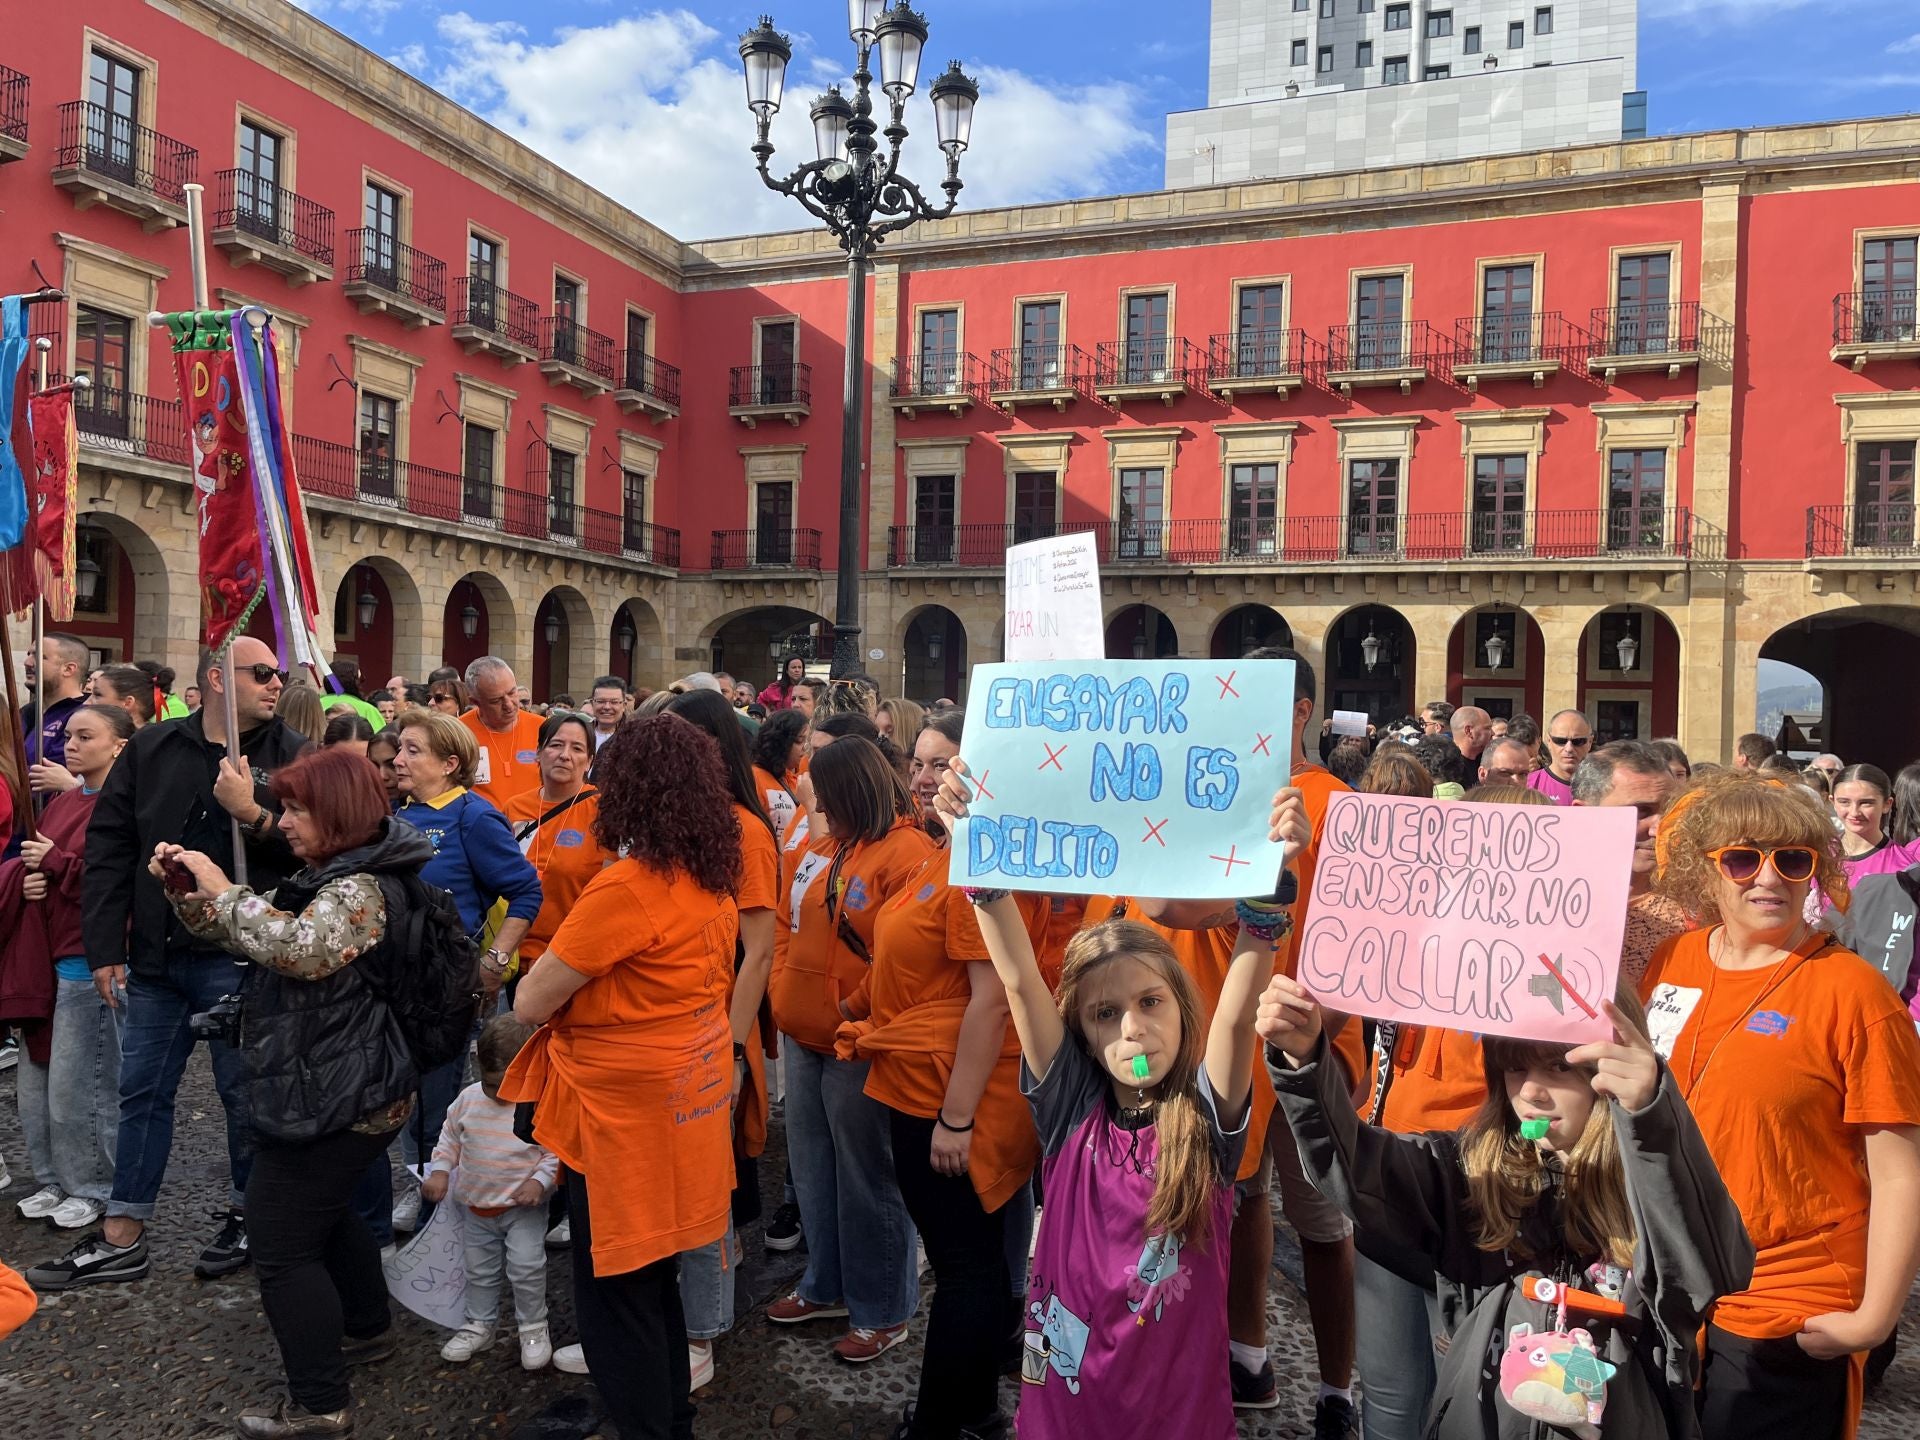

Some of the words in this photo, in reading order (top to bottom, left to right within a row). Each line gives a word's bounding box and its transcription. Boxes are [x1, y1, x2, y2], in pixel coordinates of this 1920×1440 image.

[985, 672, 1190, 734] ENSAYAR
[1090, 742, 1163, 802] NO
[1185, 746, 1240, 811] ES
[968, 815, 1120, 878] DELITO
[1326, 796, 1560, 872] QUEREMOS
[1316, 856, 1520, 928] ENSAYAR,
[1526, 877, 1591, 928] NO
[1302, 916, 1524, 1022] CALLAR
